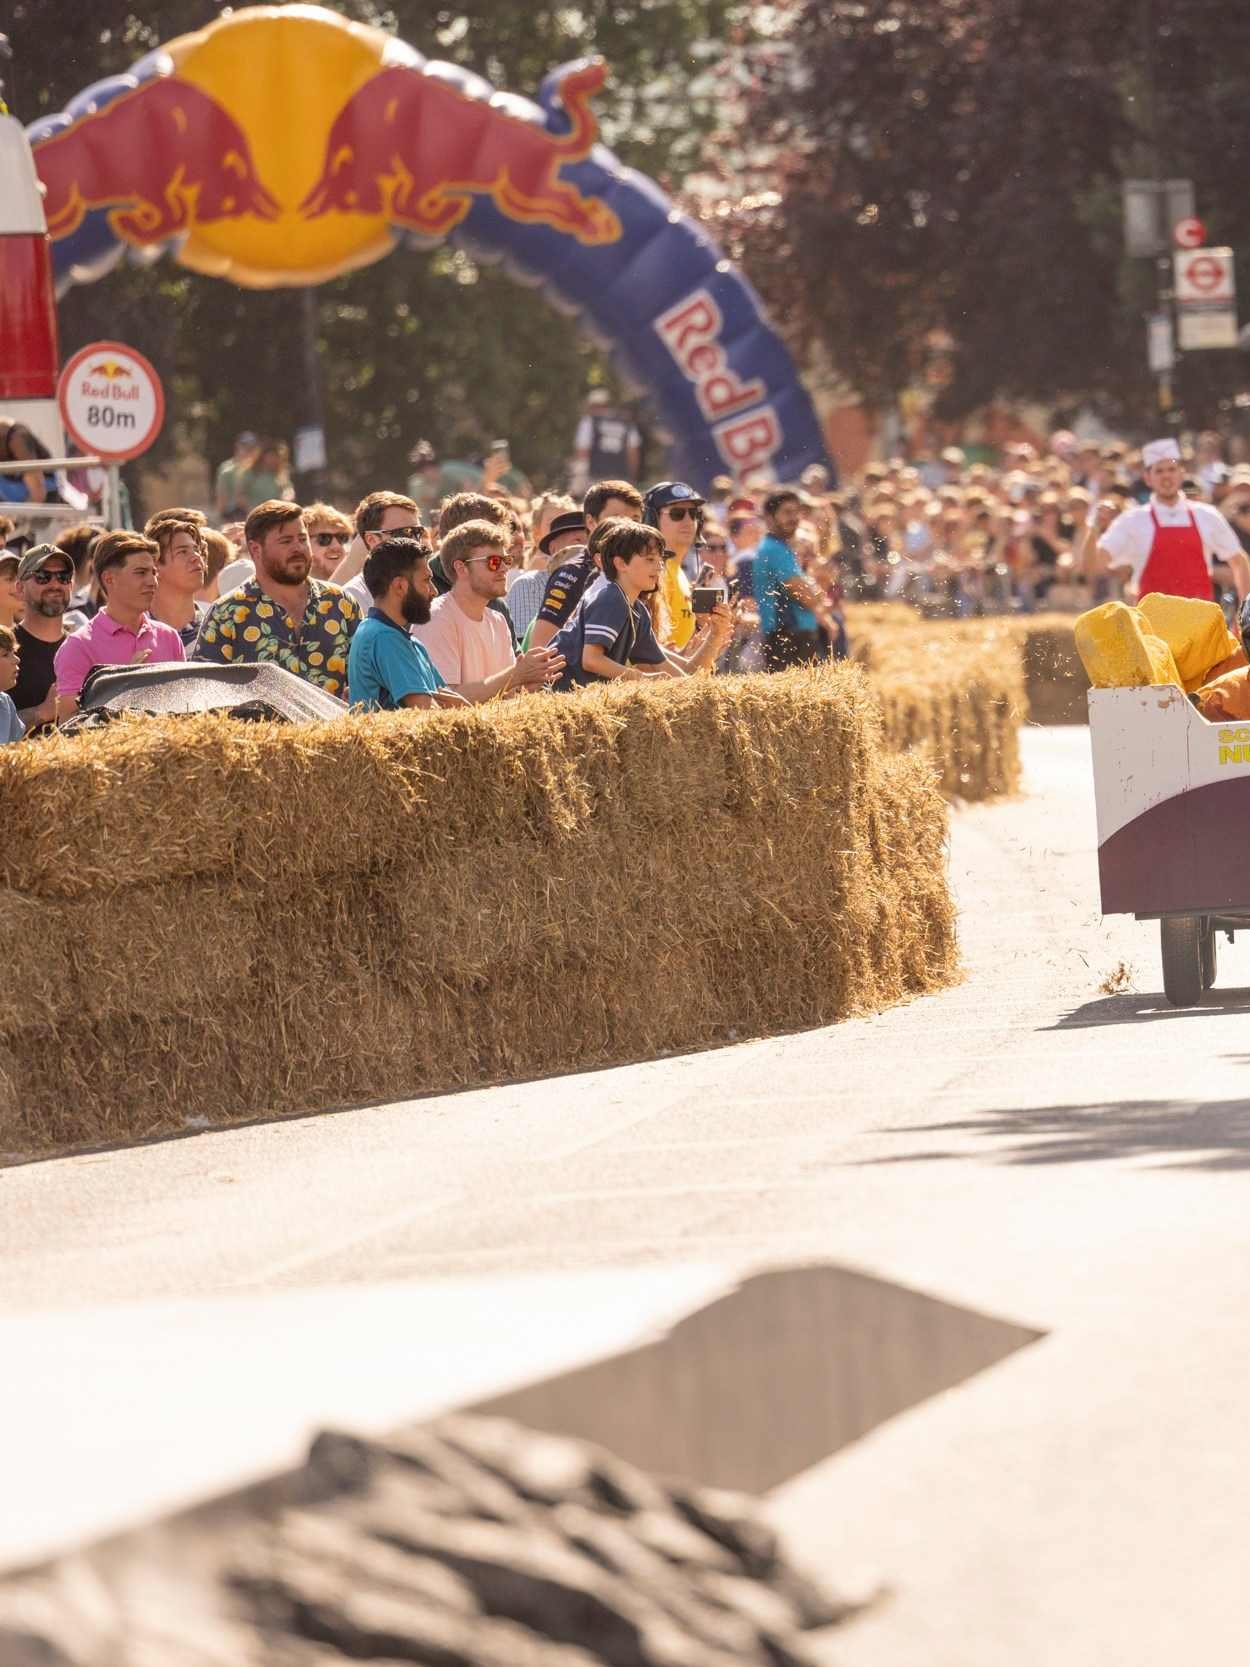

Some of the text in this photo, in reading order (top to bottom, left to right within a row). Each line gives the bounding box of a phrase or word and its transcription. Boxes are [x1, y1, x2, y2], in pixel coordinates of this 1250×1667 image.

[658, 291, 766, 419] Red
[81, 380, 140, 401] Red Bull
[86, 404, 137, 429] 80m
